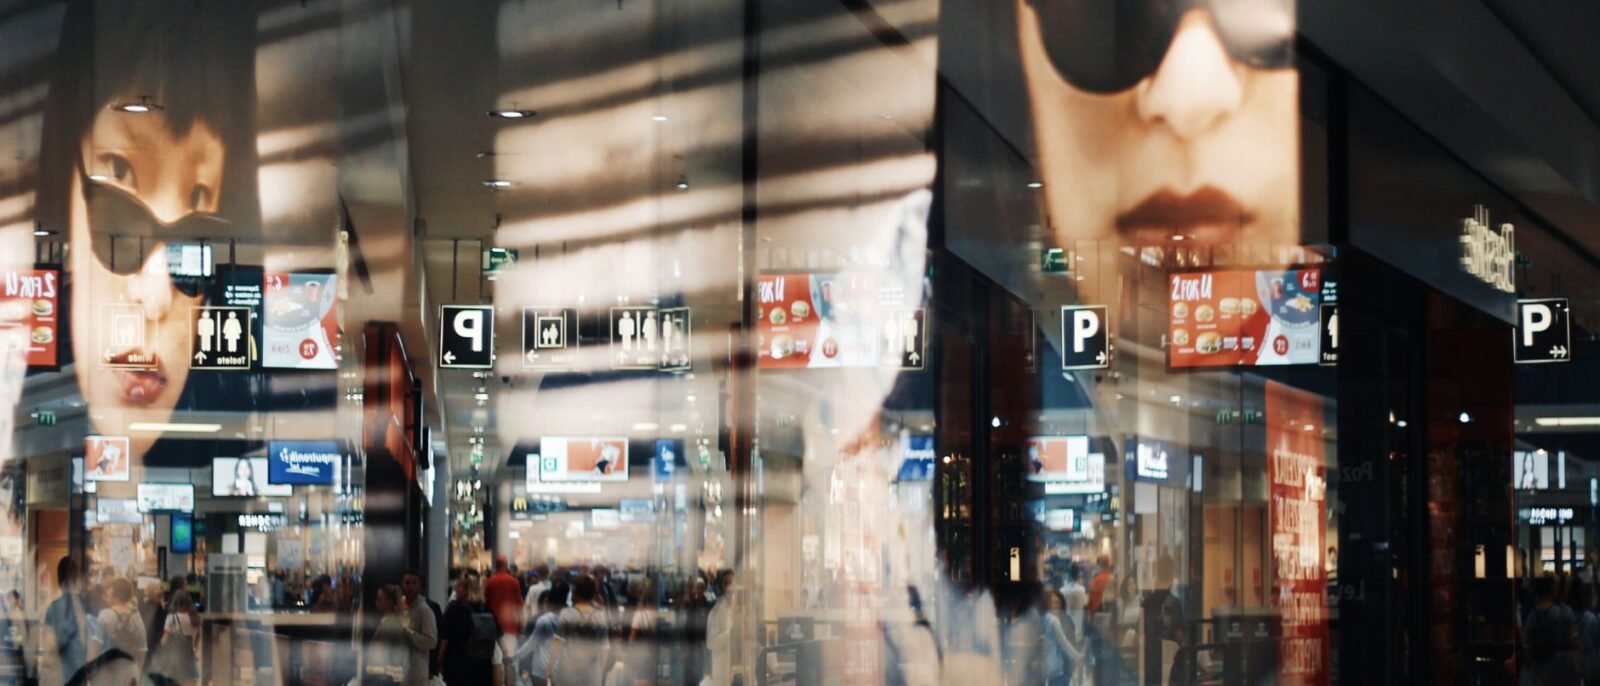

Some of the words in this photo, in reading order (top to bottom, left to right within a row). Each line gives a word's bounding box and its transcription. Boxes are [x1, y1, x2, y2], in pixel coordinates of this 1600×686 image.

[775, 276, 784, 301] U
[1171, 274, 1180, 300] 2
[1180, 281, 1200, 301] FOR
[1201, 273, 1212, 299] U
[1073, 311, 1099, 352] P
[1522, 304, 1552, 346] P
